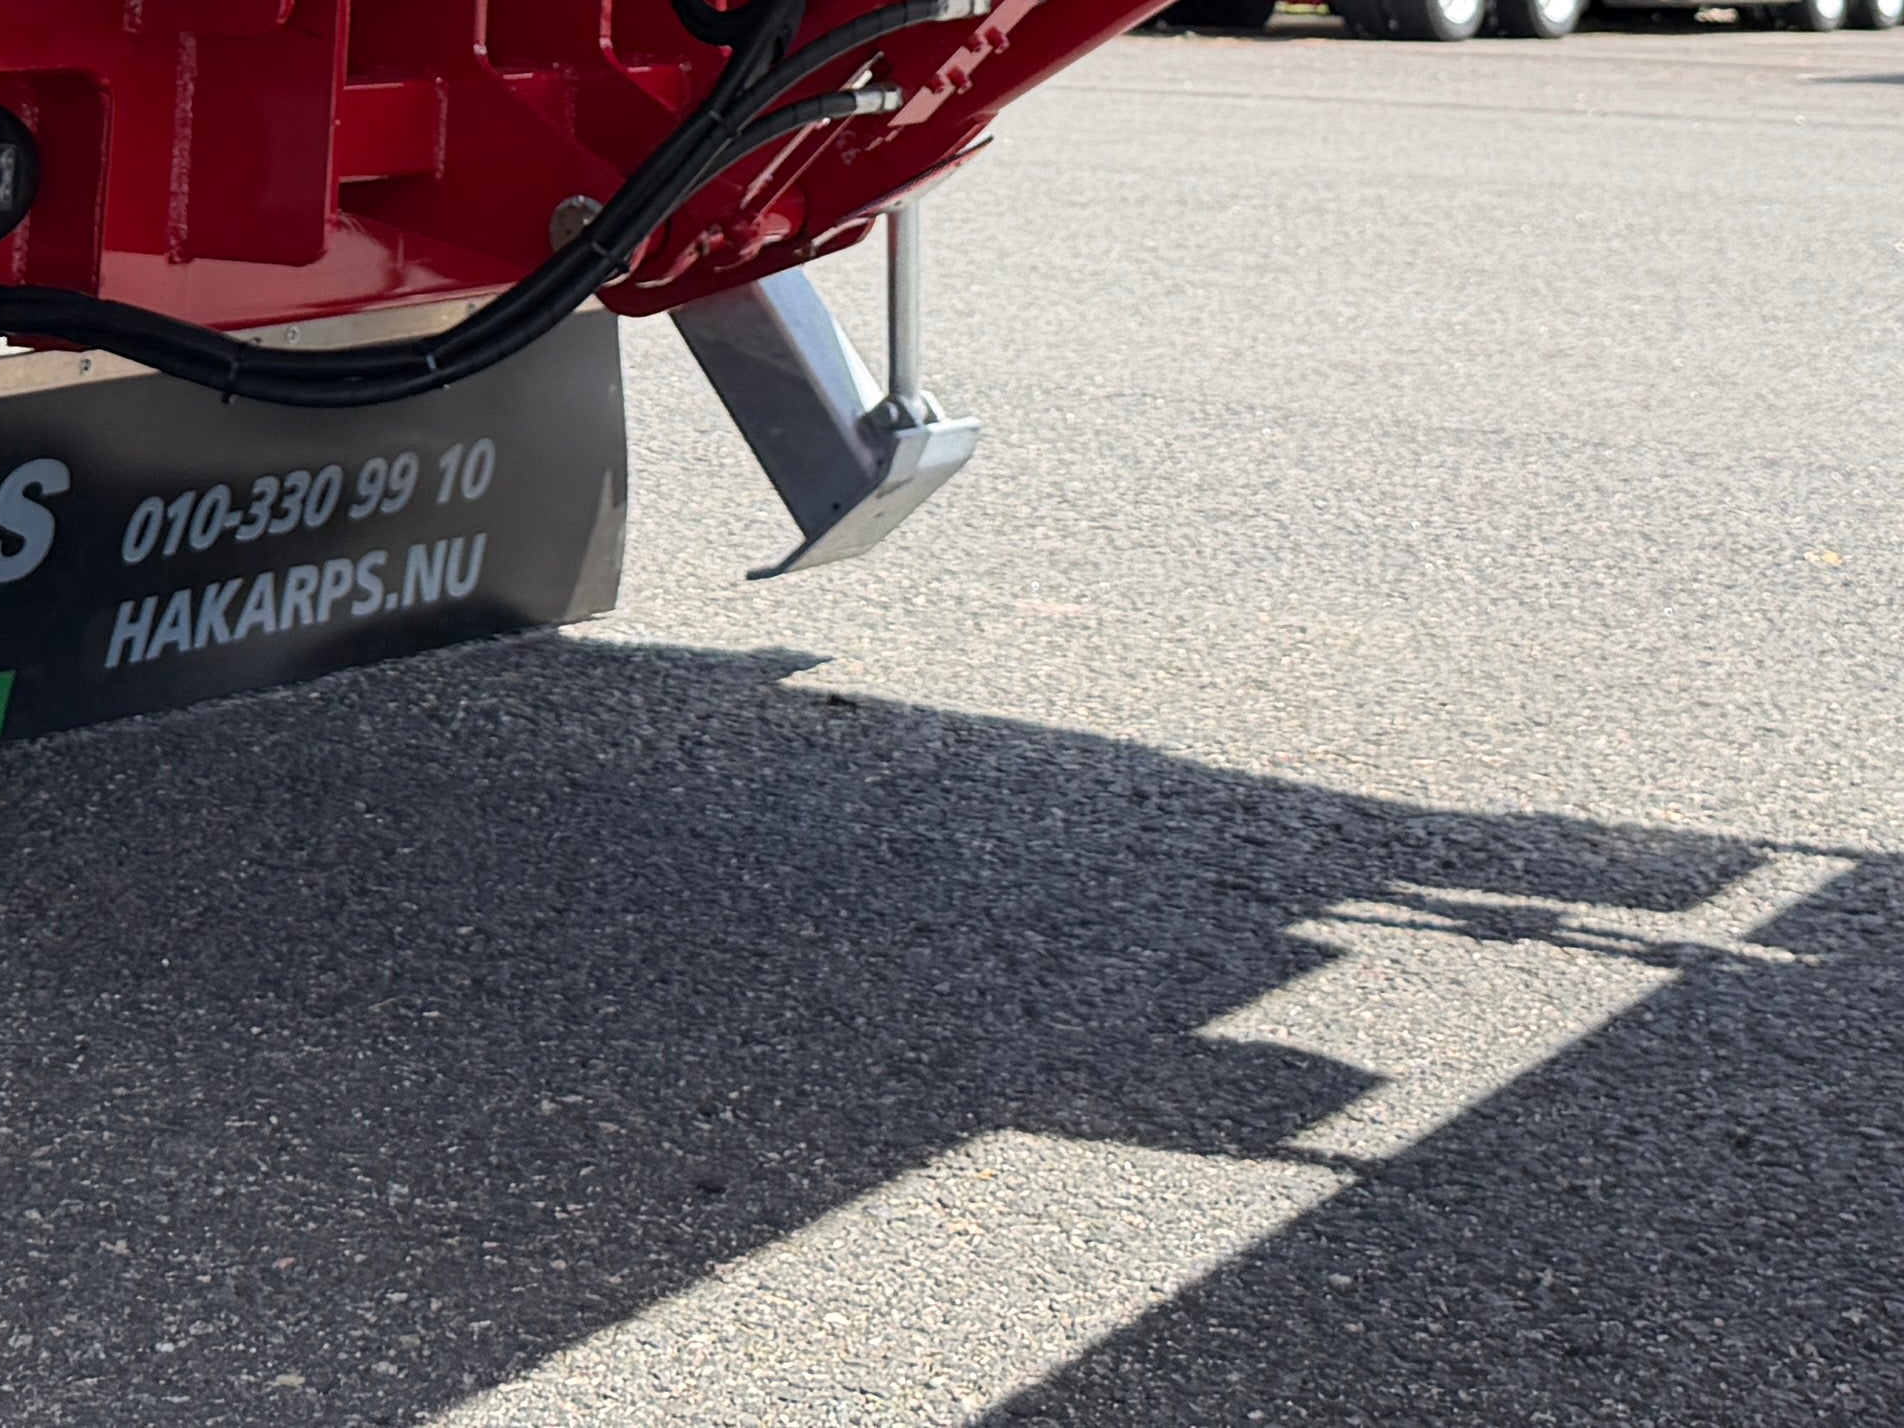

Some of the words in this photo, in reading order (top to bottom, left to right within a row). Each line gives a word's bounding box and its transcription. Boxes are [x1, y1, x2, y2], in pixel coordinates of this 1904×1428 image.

[121, 463, 344, 565] 010-330
[348, 450, 421, 521] 99
[436, 437, 496, 504] 10
[104, 532, 488, 670] HAKARPS.NU
